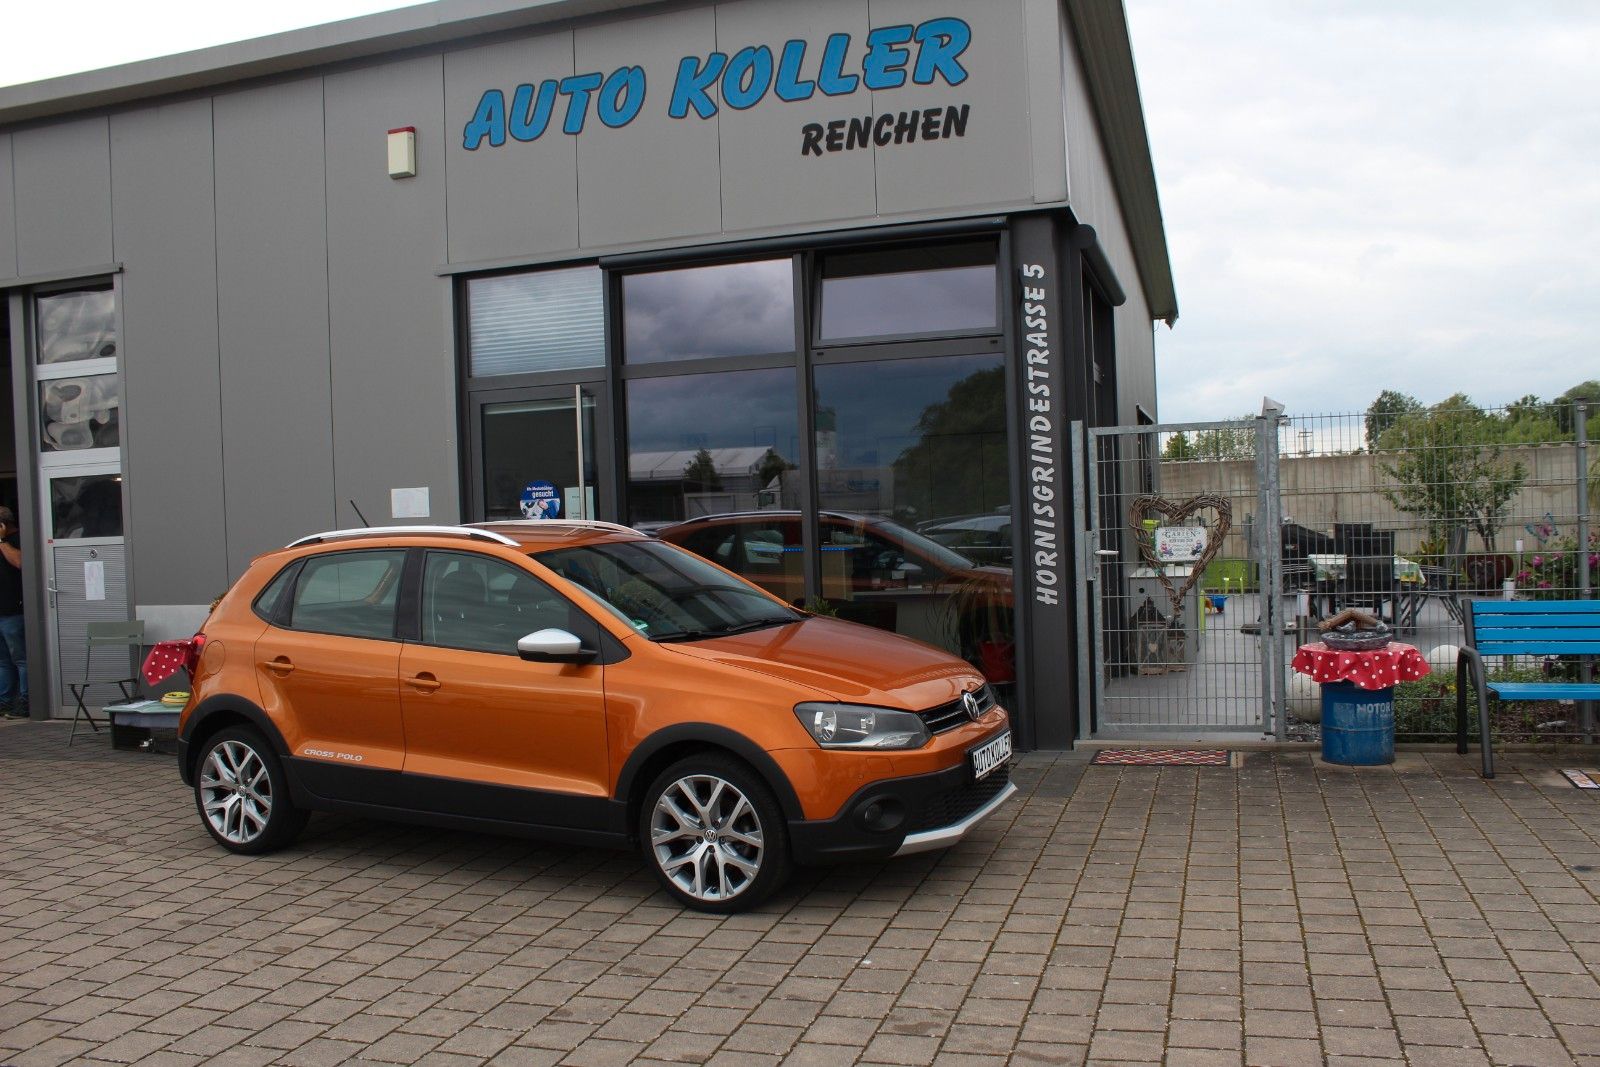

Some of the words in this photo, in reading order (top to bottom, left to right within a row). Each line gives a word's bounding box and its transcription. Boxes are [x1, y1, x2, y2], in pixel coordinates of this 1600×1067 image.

[463, 65, 646, 150] AUTO
[669, 17, 971, 119] KOLLER
[802, 104, 970, 156] RENCHEN
[1023, 264, 1045, 279] 5
[1024, 286, 1058, 605] HORNISGRINDESTRASSE
[304, 748, 334, 758] CROSS
[336, 752, 363, 761] POLO
